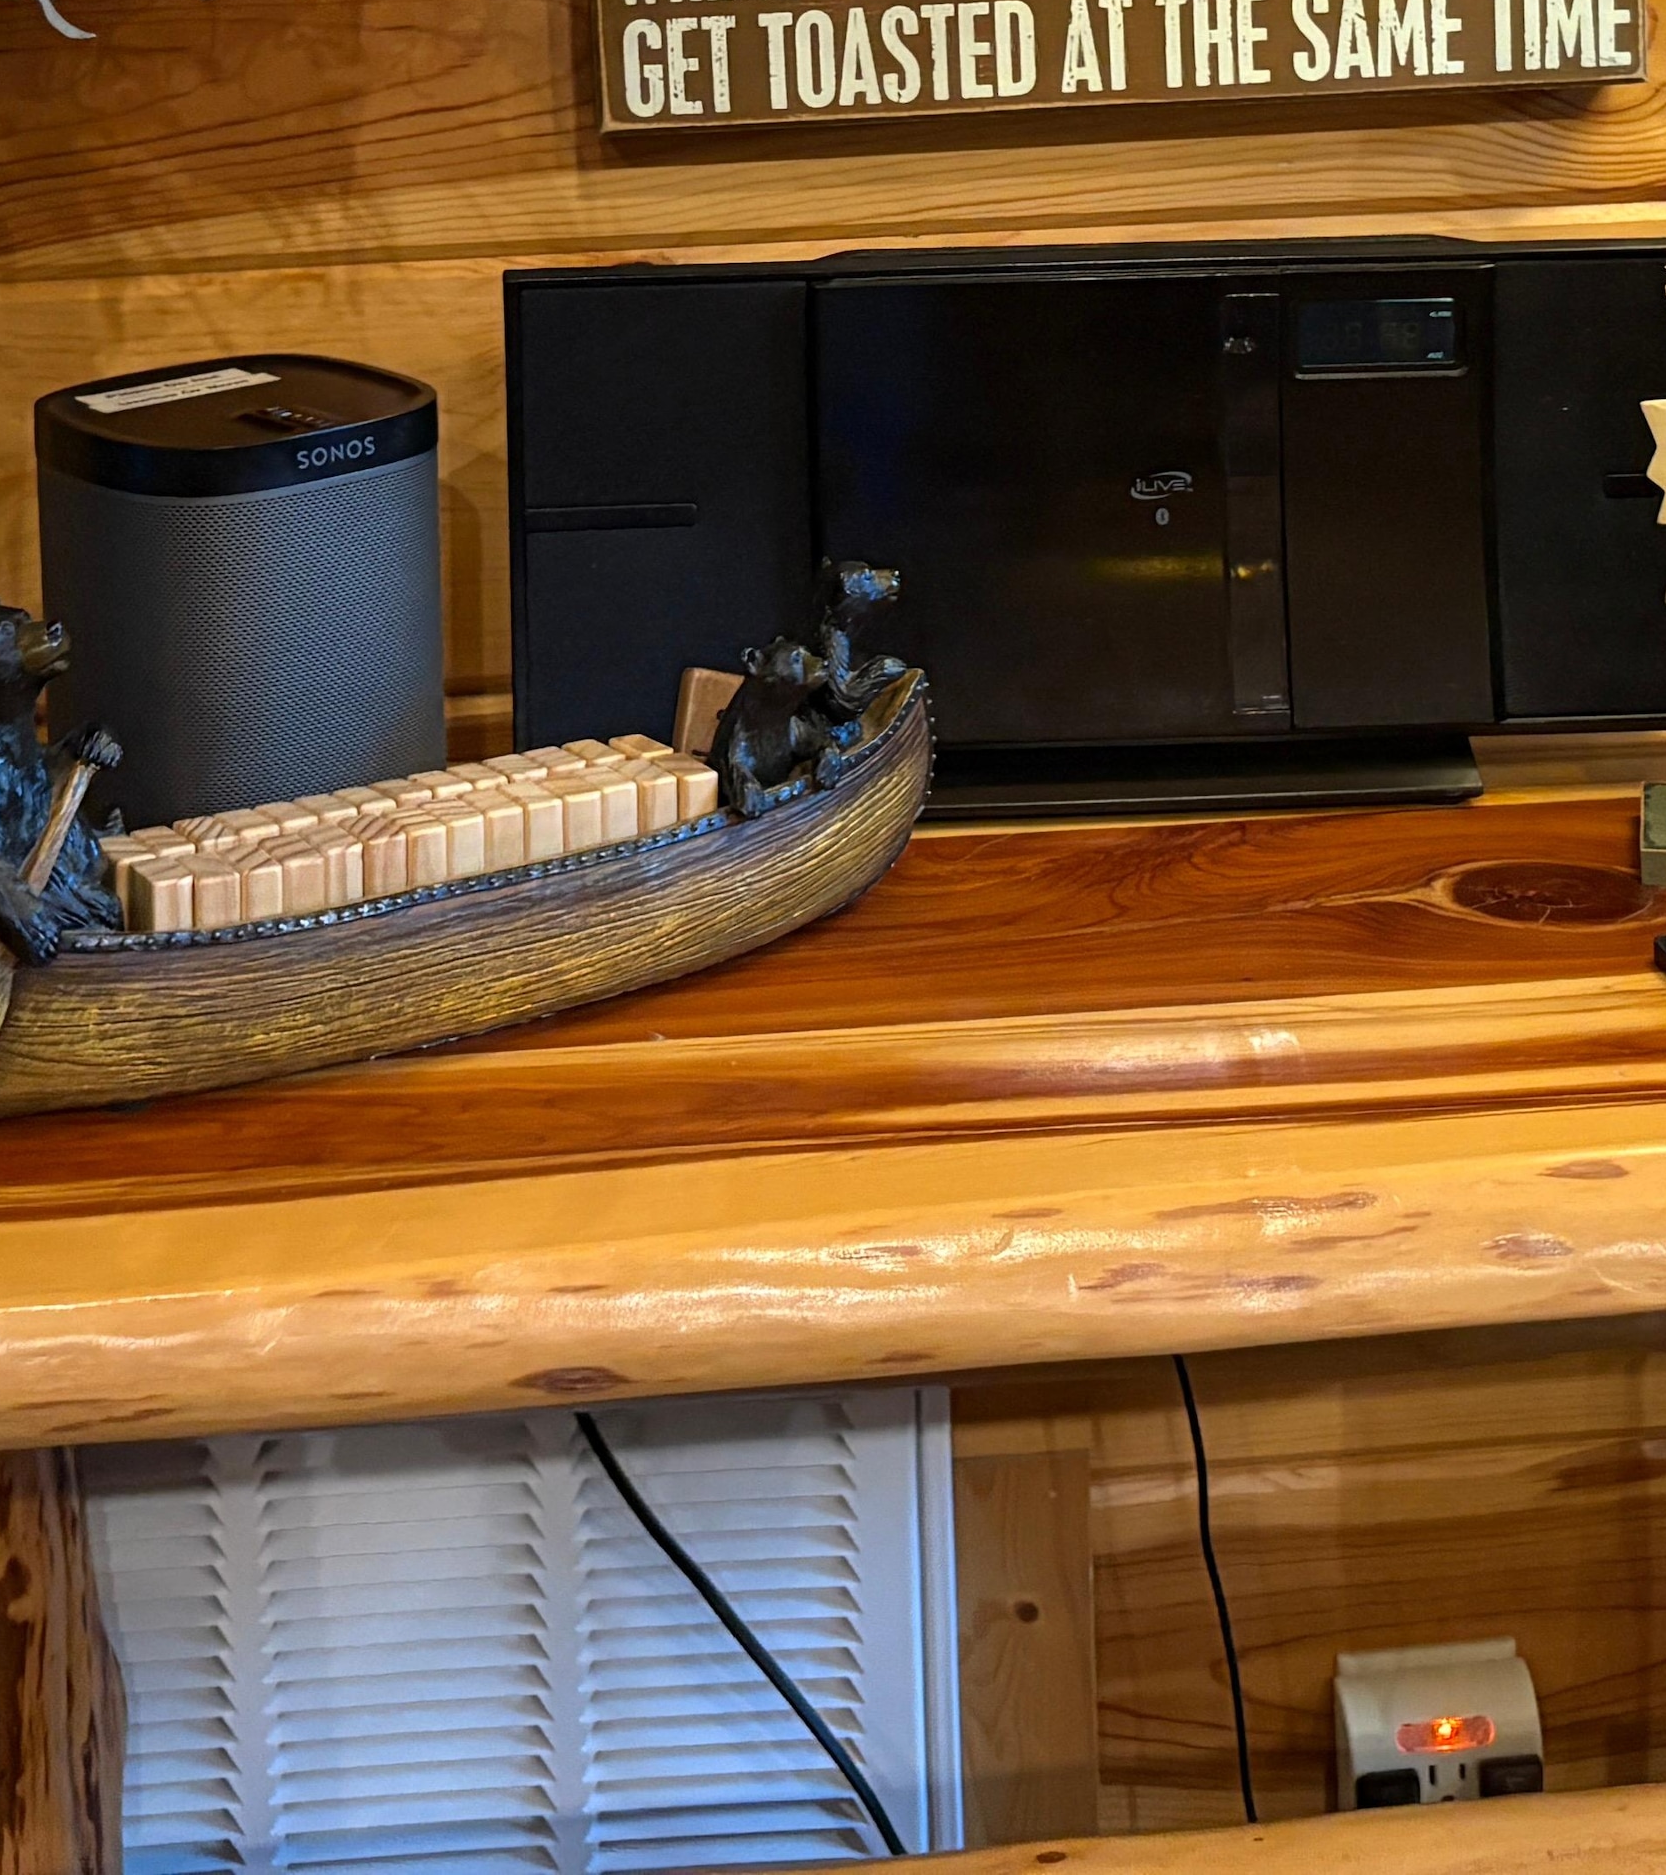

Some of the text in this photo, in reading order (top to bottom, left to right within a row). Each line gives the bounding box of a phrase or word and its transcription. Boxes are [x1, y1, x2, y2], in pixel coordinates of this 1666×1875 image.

[623, 15, 736, 118] GET
[758, 0, 1037, 110] TOASTED
[296, 435, 376, 470] SONOS
